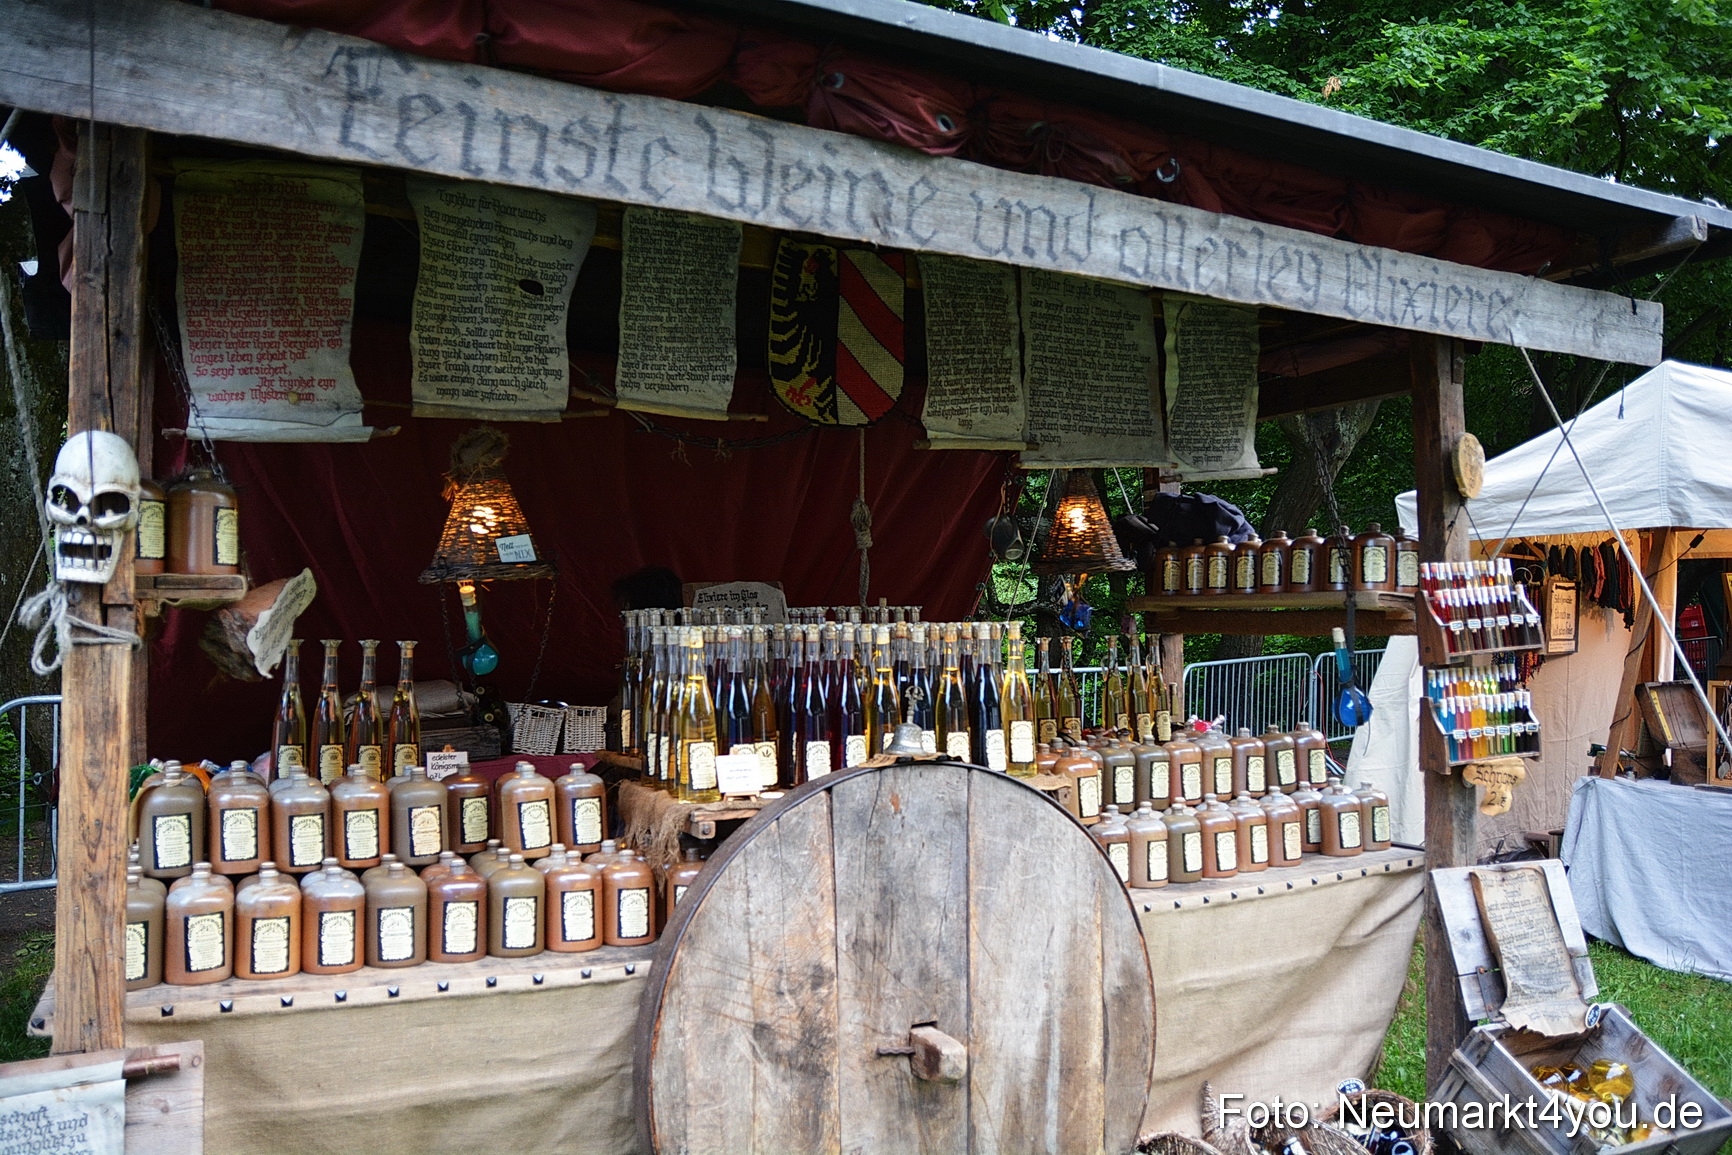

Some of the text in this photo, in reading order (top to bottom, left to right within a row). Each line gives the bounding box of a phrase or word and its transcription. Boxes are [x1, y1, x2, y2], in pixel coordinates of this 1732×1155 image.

[324, 46, 1516, 339] Feinste Weine und allerley Elixiere
[190, 352, 224, 366] langes
[193, 366, 208, 377] So
[211, 366, 234, 379] seyd
[318, 378, 336, 389] eyn
[57, 1112, 88, 1134] und
